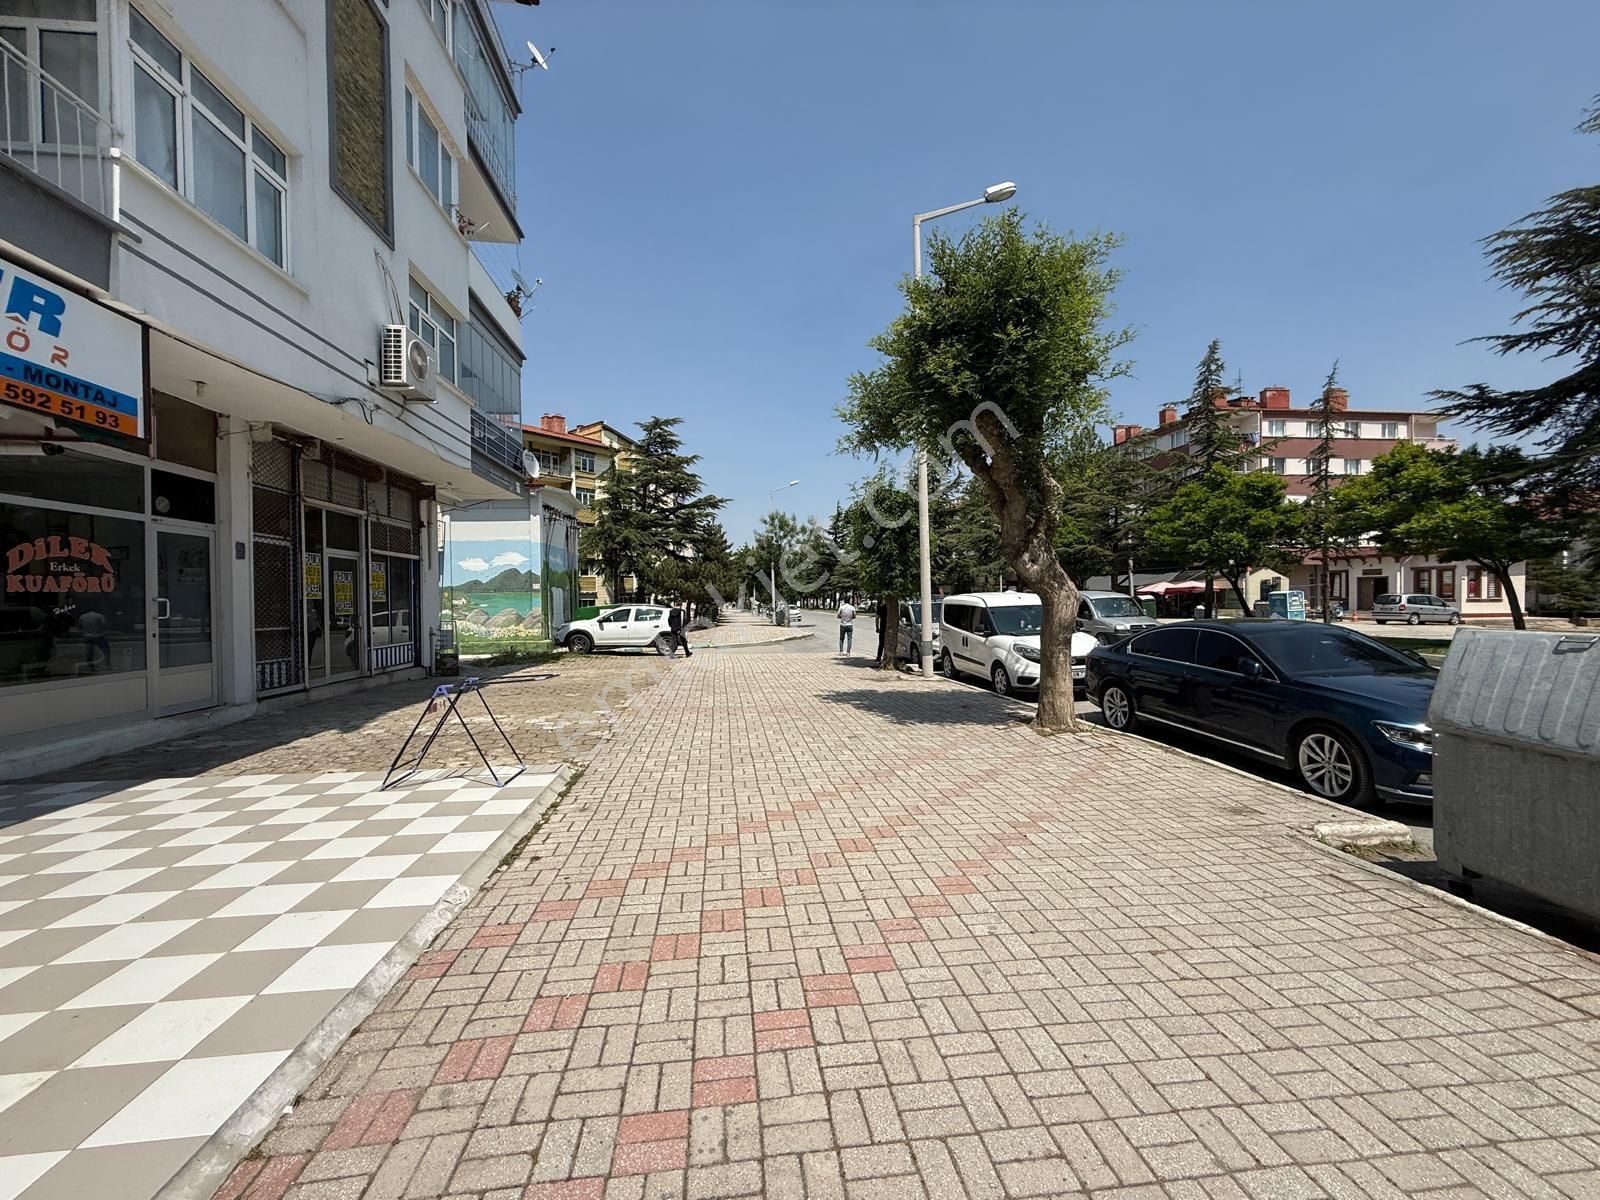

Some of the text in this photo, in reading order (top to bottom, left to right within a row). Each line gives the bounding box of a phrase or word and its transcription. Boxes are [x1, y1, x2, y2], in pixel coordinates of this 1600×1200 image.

[23, 364, 119, 409] MONTAJ
[5, 382, 120, 429] 592 51 93
[6, 572, 116, 592] KUAFÖRÜ
[50, 562, 81, 572] Erkek
